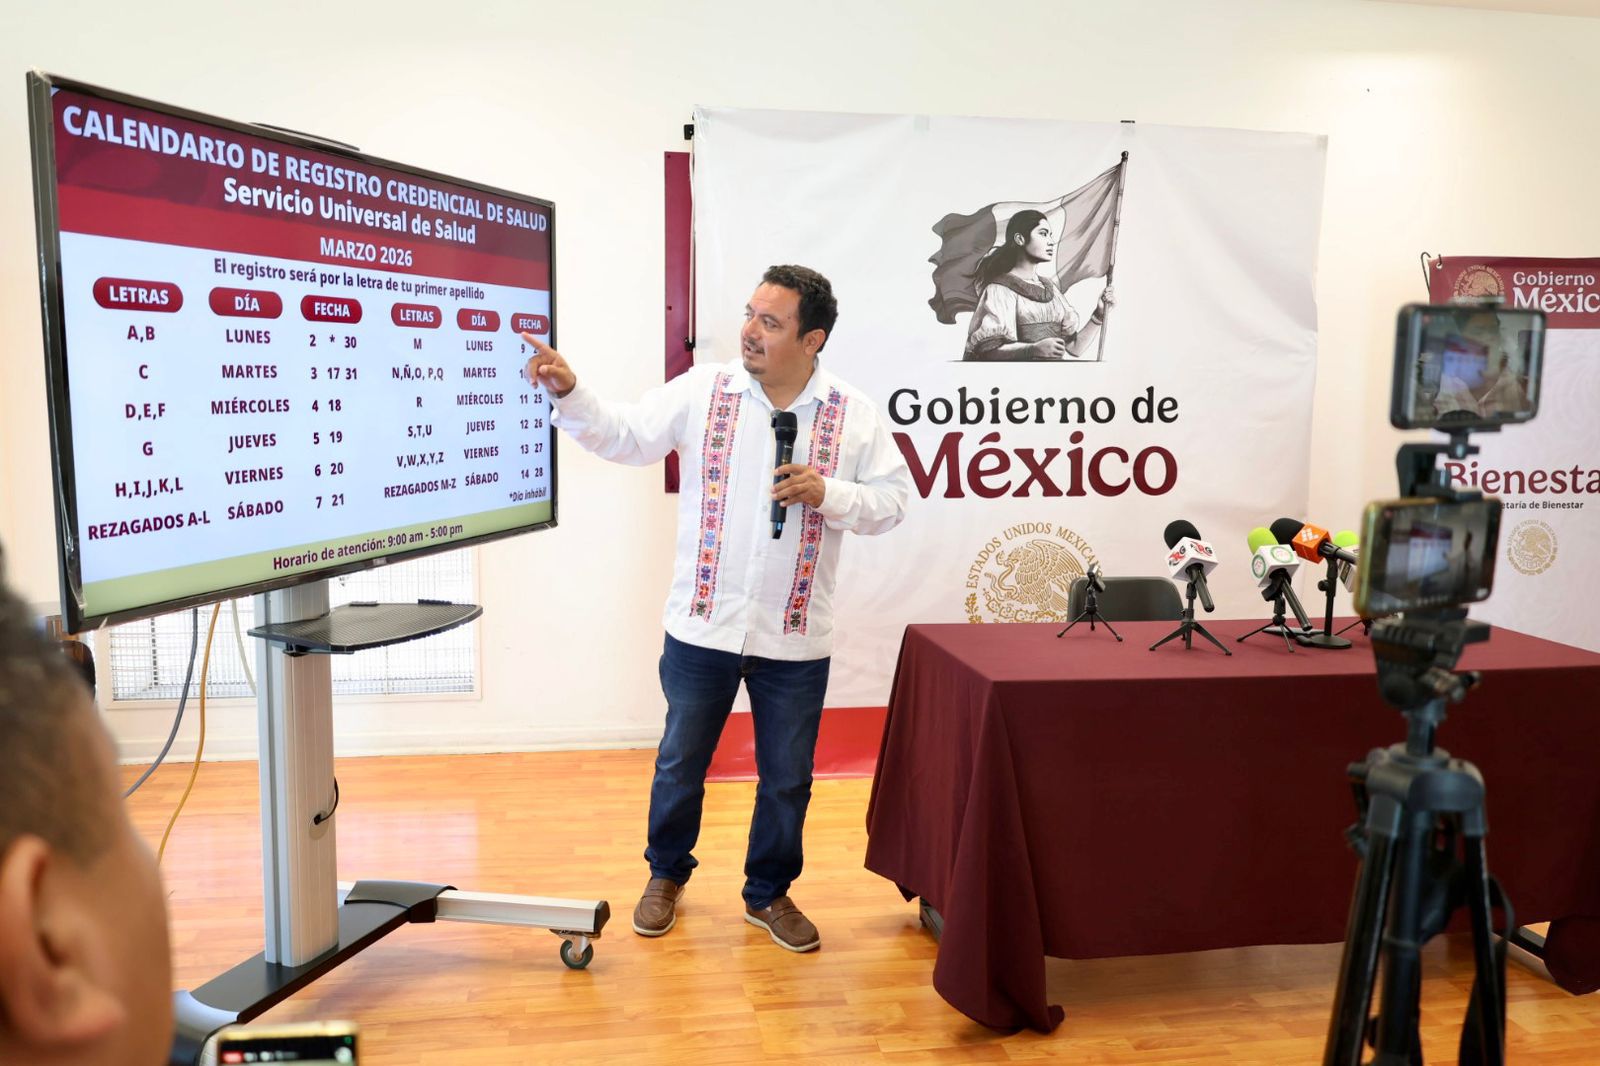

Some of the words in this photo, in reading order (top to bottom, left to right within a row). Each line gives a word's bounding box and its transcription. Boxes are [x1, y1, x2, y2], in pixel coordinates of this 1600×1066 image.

[63, 105, 244, 169] CALENDARIO
[252, 148, 279, 177] DE
[286, 155, 382, 198] REGISTRO
[386, 180, 483, 219] CREDENCIAL
[487, 202, 504, 224] DE
[506, 210, 546, 232] SALUD
[224, 178, 314, 216] Servicio
[320, 195, 406, 232] Universal
[412, 211, 430, 236] de
[435, 218, 476, 244] Salud
[320, 237, 376, 262] MARZO
[380, 246, 413, 267] 2026
[214, 258, 226, 274] El
[231, 263, 286, 281] registro
[290, 268, 316, 283] será
[320, 272, 340, 288] por
[344, 272, 354, 288] la
[357, 274, 383, 290] letra
[386, 277, 398, 292] de
[401, 280, 412, 292] tu
[415, 282, 447, 298] primer
[450, 286, 484, 300] apellido
[1512, 270, 1596, 286] Gobierno
[109, 285, 169, 305] LETRAS
[234, 294, 260, 312] DÍA
[314, 302, 350, 318] FECHA
[400, 308, 434, 322] LETRAS
[472, 313, 486, 327] DÍA
[519, 318, 542, 330] FECHA
[1512, 287, 1600, 313] Méxic
[127, 325, 155, 342] A,B
[226, 329, 271, 344] LUNES
[310, 334, 316, 347] 2
[344, 336, 357, 348] 30
[414, 338, 422, 350] M
[466, 340, 493, 352] LUNES
[521, 344, 526, 354] 9
[138, 364, 148, 380] C
[222, 364, 278, 378] MARTES
[310, 367, 318, 380] 3
[328, 367, 340, 380] 17
[345, 368, 358, 380] 31
[463, 366, 496, 378] MARTES
[125, 402, 166, 421] D,E,F
[211, 396, 290, 415] MIÉRCOLES
[312, 400, 318, 412] 4
[328, 400, 342, 412] 18
[416, 396, 422, 408] R
[456, 392, 504, 406] MIÉRCOLES
[520, 394, 528, 404] 11
[534, 394, 543, 404] 25
[888, 386, 1116, 426] Gobierno
[1132, 386, 1178, 423] de
[142, 441, 154, 456] G
[228, 434, 276, 452] JUEVES
[313, 432, 320, 444] 5
[330, 431, 342, 444] 19
[408, 424, 432, 438] S,T,U
[466, 420, 496, 434] JUEVES
[520, 419, 528, 429] 12
[534, 418, 543, 428] 26
[115, 476, 184, 499] H,I,J,K,L
[224, 466, 284, 485] VIERNES
[314, 464, 321, 476] 6
[330, 462, 344, 475] 20
[397, 452, 444, 468] V,W,X,Y,Z
[464, 446, 499, 460] VIERNES
[520, 444, 529, 454] 13
[534, 443, 543, 453] 27
[892, 430, 1178, 499] México
[1444, 461, 1600, 494] Bienesta
[88, 512, 184, 540] REZAGADOS
[188, 510, 210, 527] A-L
[228, 499, 284, 520] SÁBADO
[316, 496, 322, 509] 7
[332, 494, 344, 506] 21
[384, 480, 439, 498] REZAGADOS
[440, 478, 456, 490] M-Z
[465, 472, 499, 486] SÁBADO
[521, 469, 530, 480] 14
[535, 467, 544, 478] 28
[1529, 501, 1540, 509] de
[1542, 501, 1584, 510] Bienestar
[273, 549, 318, 570] Horario
[321, 544, 334, 559] de
[338, 538, 386, 558] atención:
[388, 533, 407, 548] 9:00
[410, 532, 424, 544] am
[430, 526, 448, 538] 5:00
[450, 524, 464, 538] pm
[966, 536, 1002, 590] ESTADOS
[1003, 522, 1052, 541] UNIDOS
